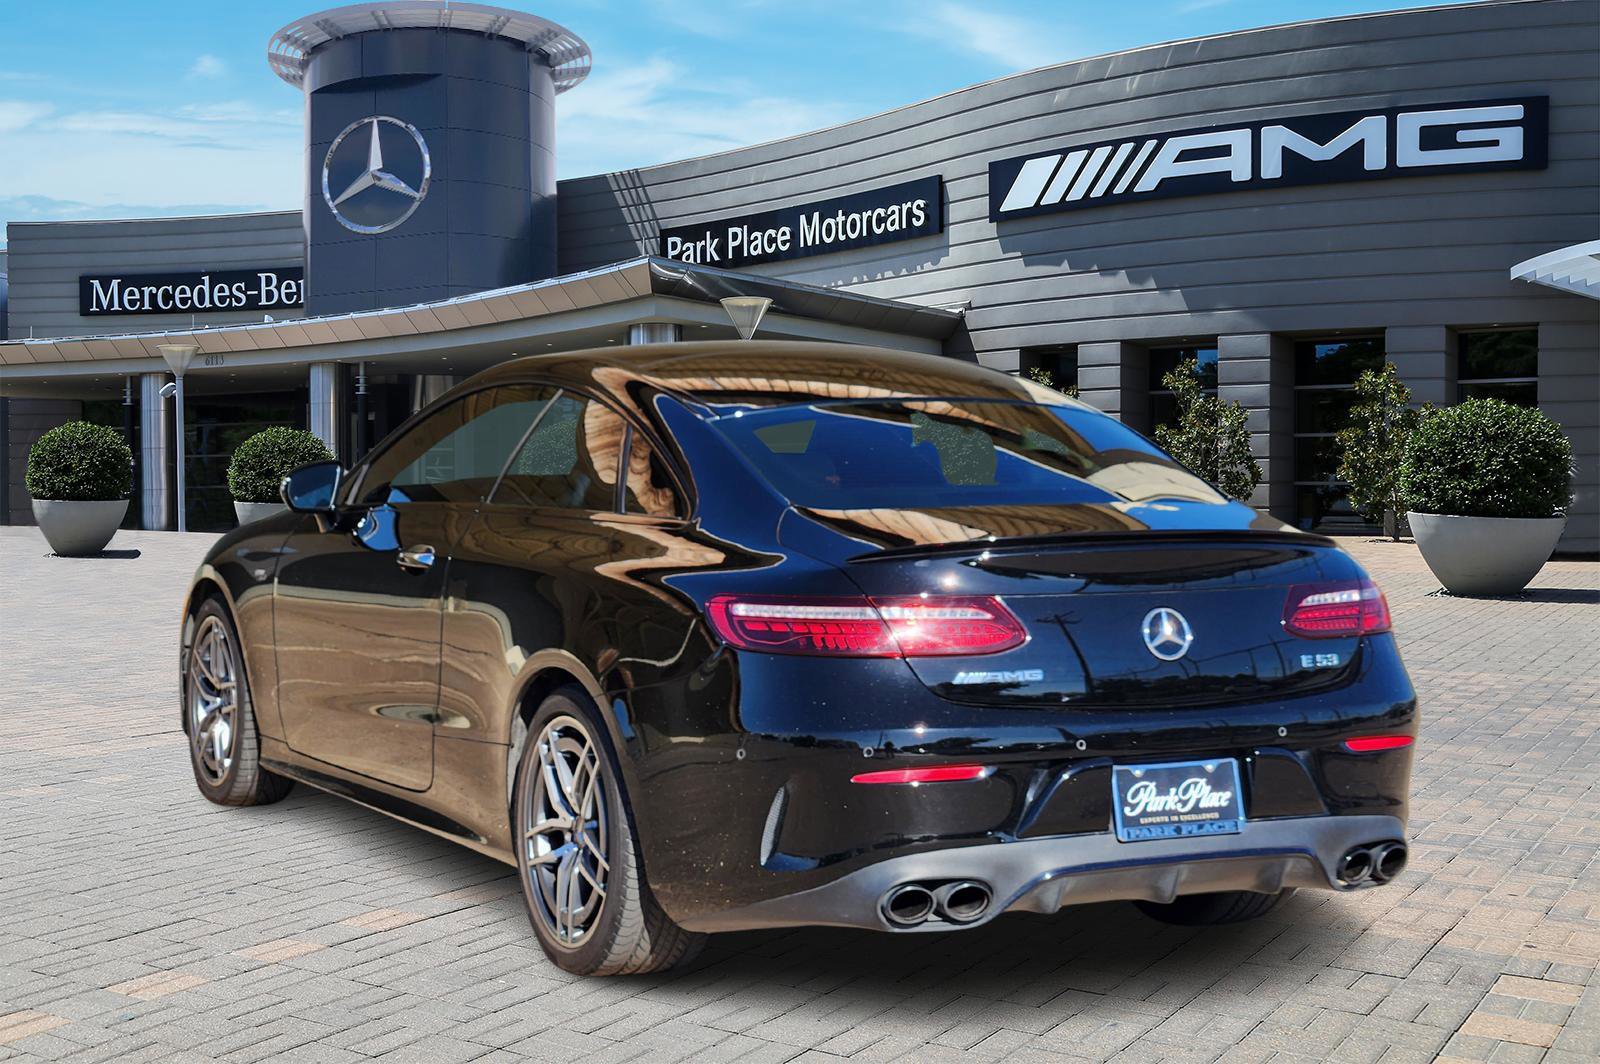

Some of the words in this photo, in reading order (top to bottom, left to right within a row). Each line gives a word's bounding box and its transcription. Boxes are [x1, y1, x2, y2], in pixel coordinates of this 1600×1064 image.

[667, 231, 720, 264] Park
[727, 225, 791, 259] Place
[799, 199, 926, 248] Motorcars
[1300, 654, 1314, 668] E
[1124, 781, 1180, 816] Park
[1177, 778, 1232, 812] Place
[1126, 826, 1177, 839] PARK
[1180, 821, 1239, 835] PLACE
